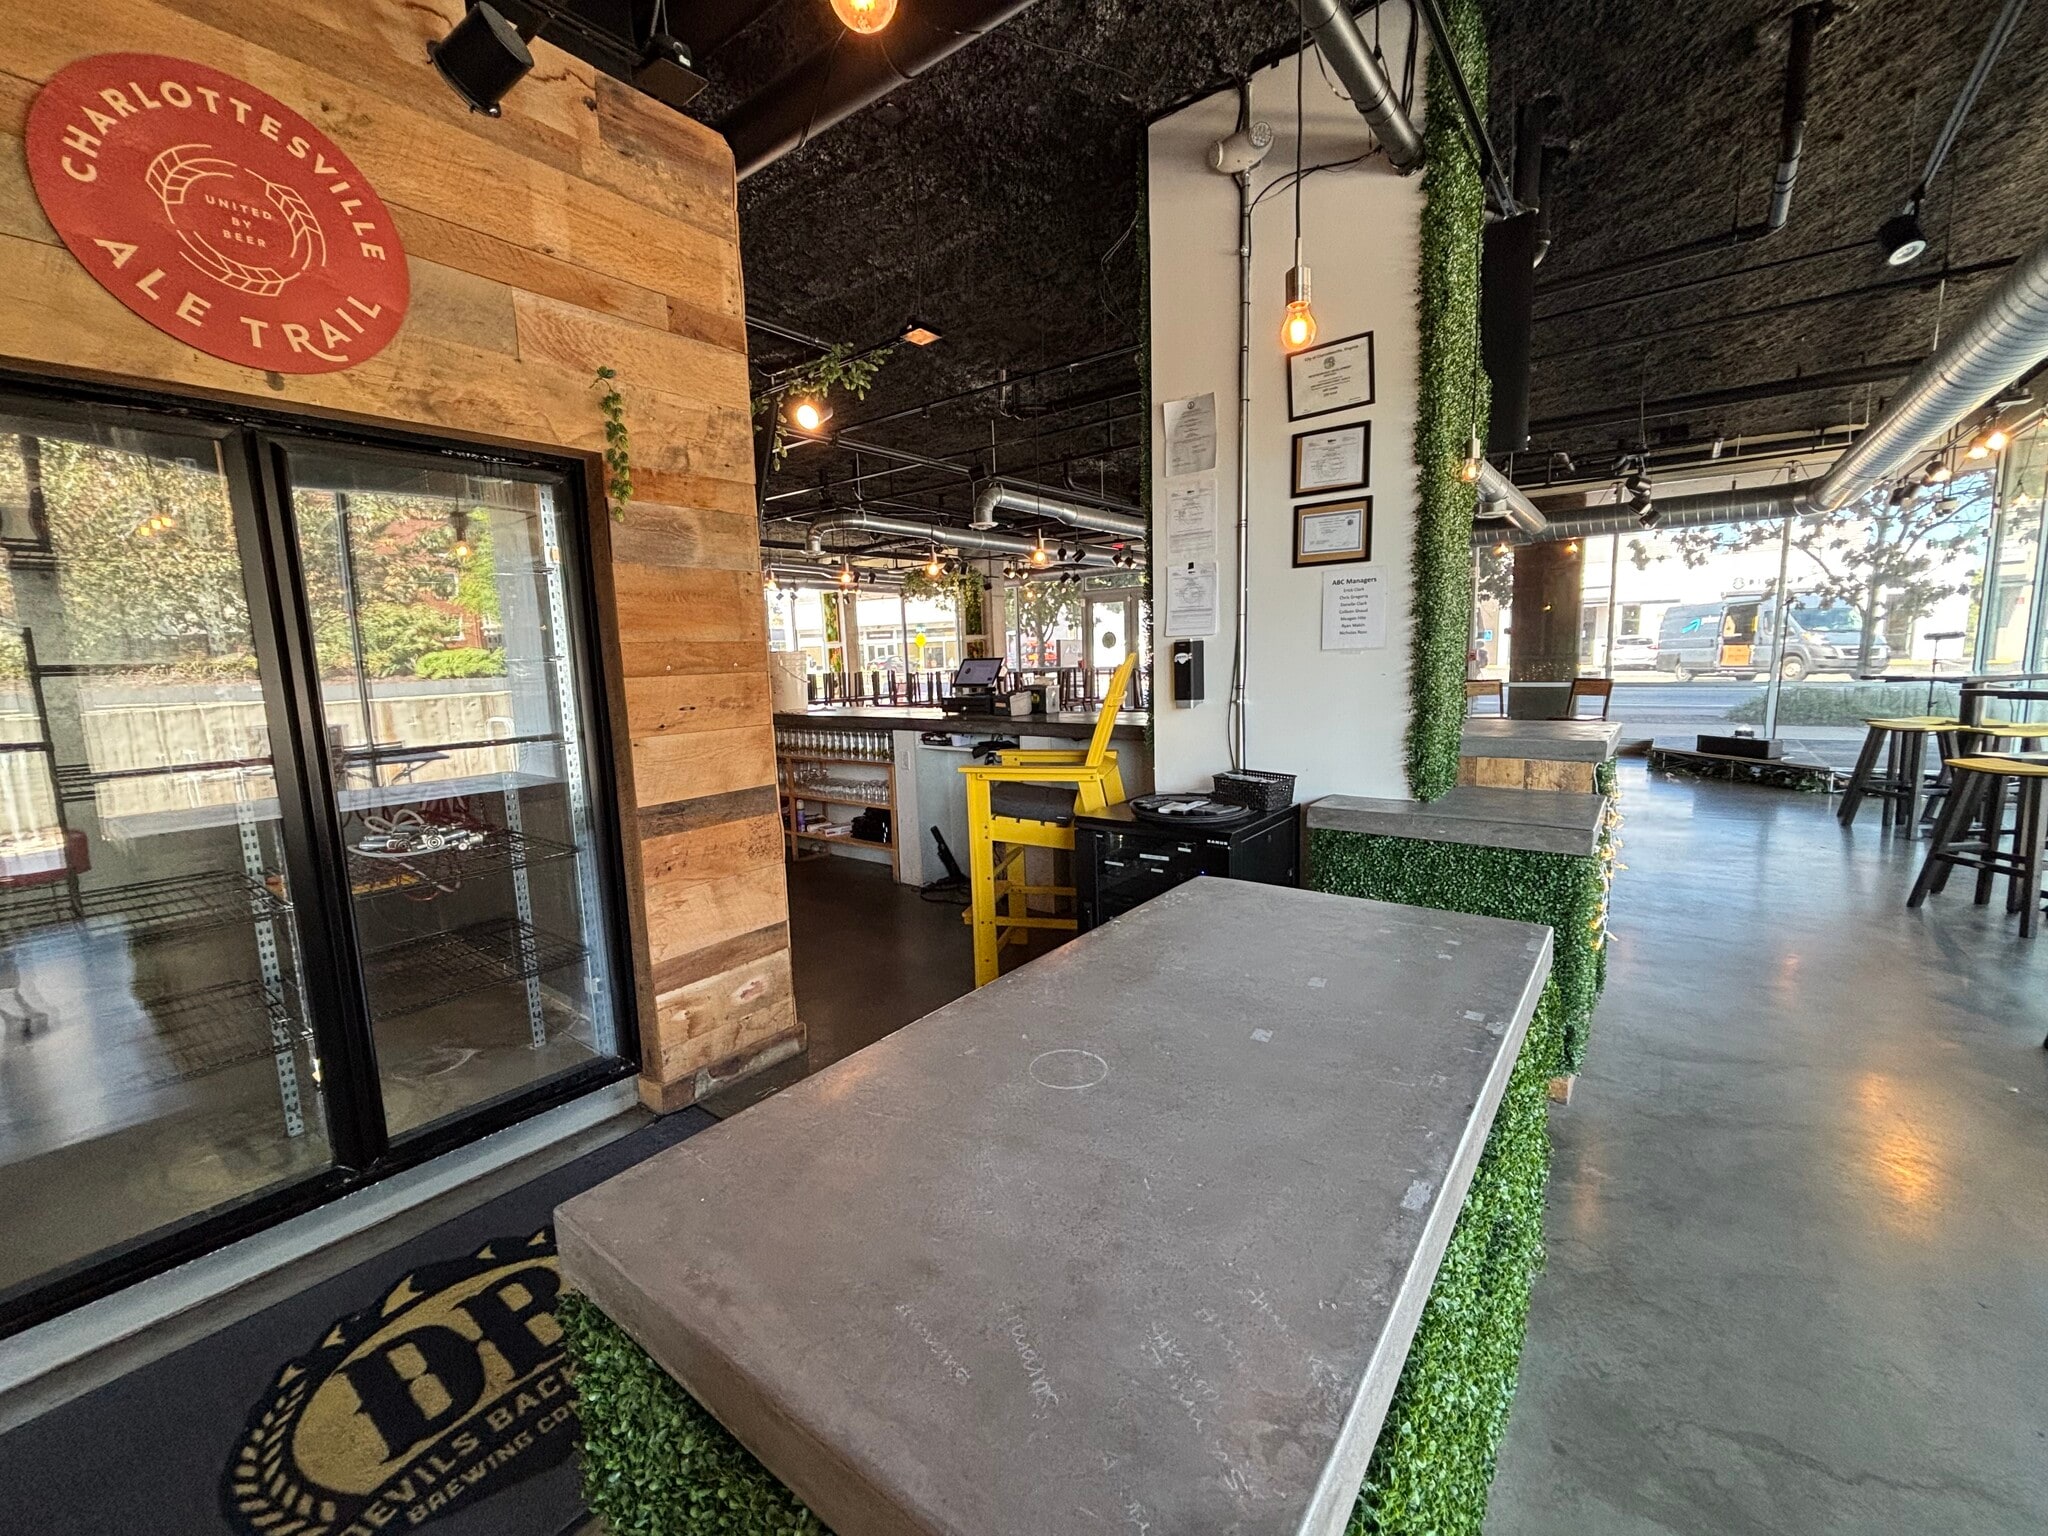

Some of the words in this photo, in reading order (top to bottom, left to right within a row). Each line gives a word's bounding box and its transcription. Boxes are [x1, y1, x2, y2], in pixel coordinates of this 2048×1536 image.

[61, 81, 386, 261] CHARLOTTESVILLE
[204, 194, 273, 221] UNITED
[231, 216, 252, 229] BY
[222, 229, 267, 249] BEER
[94, 238, 212, 327] ALE
[239, 295, 382, 362] TRAIL
[1346, 577, 1377, 585] Managers
[406, 1430, 534, 1524] BREWING
